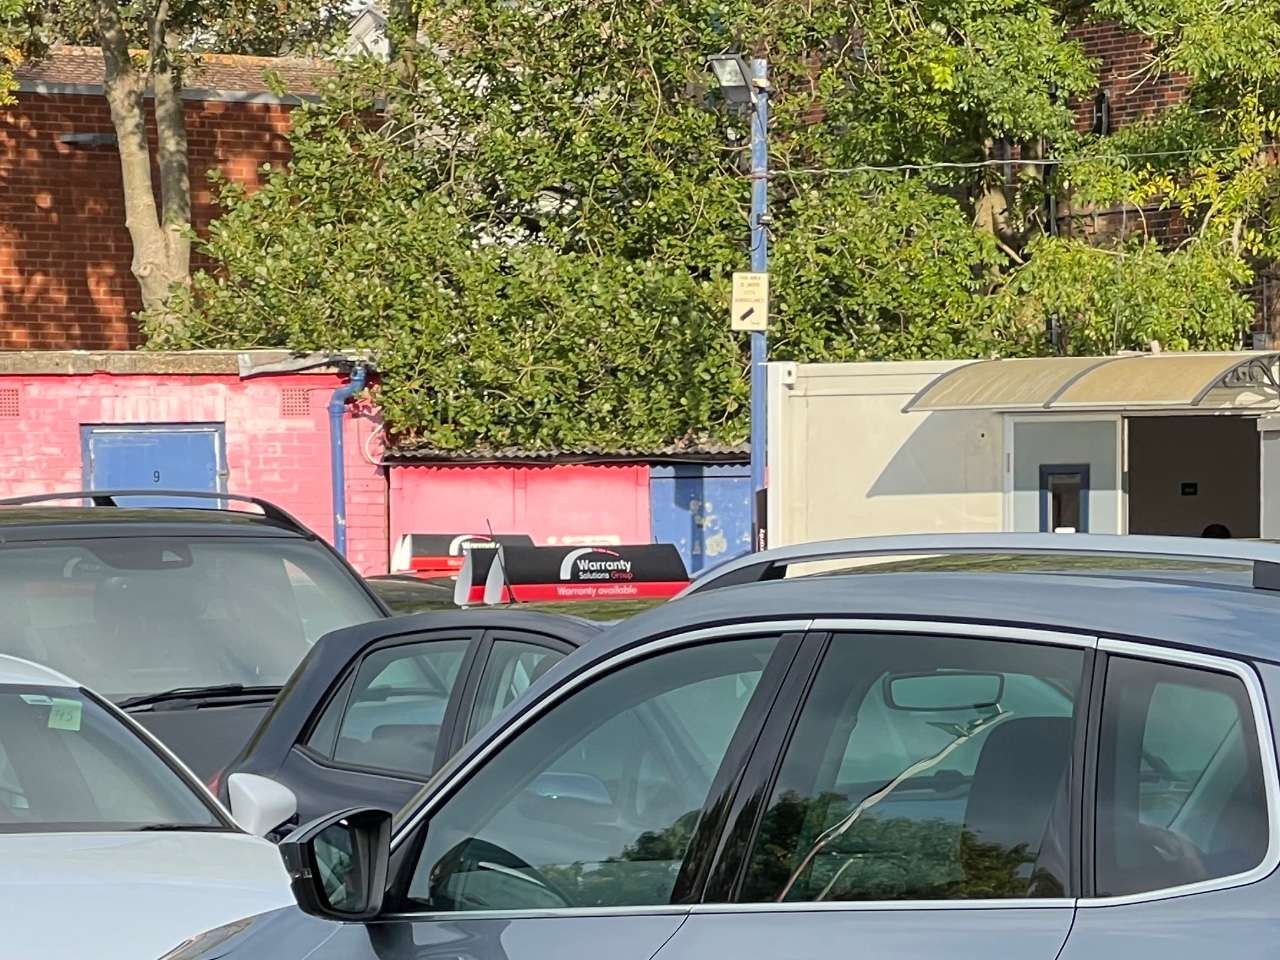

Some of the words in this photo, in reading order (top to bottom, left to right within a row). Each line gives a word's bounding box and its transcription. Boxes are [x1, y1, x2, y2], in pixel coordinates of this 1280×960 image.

[153, 470, 160, 483] 9
[577, 559, 632, 573] Warranty
[579, 572, 610, 580] Solutions
[611, 571, 633, 579] Group
[557, 587, 597, 598] Warranty
[598, 584, 638, 595] available
